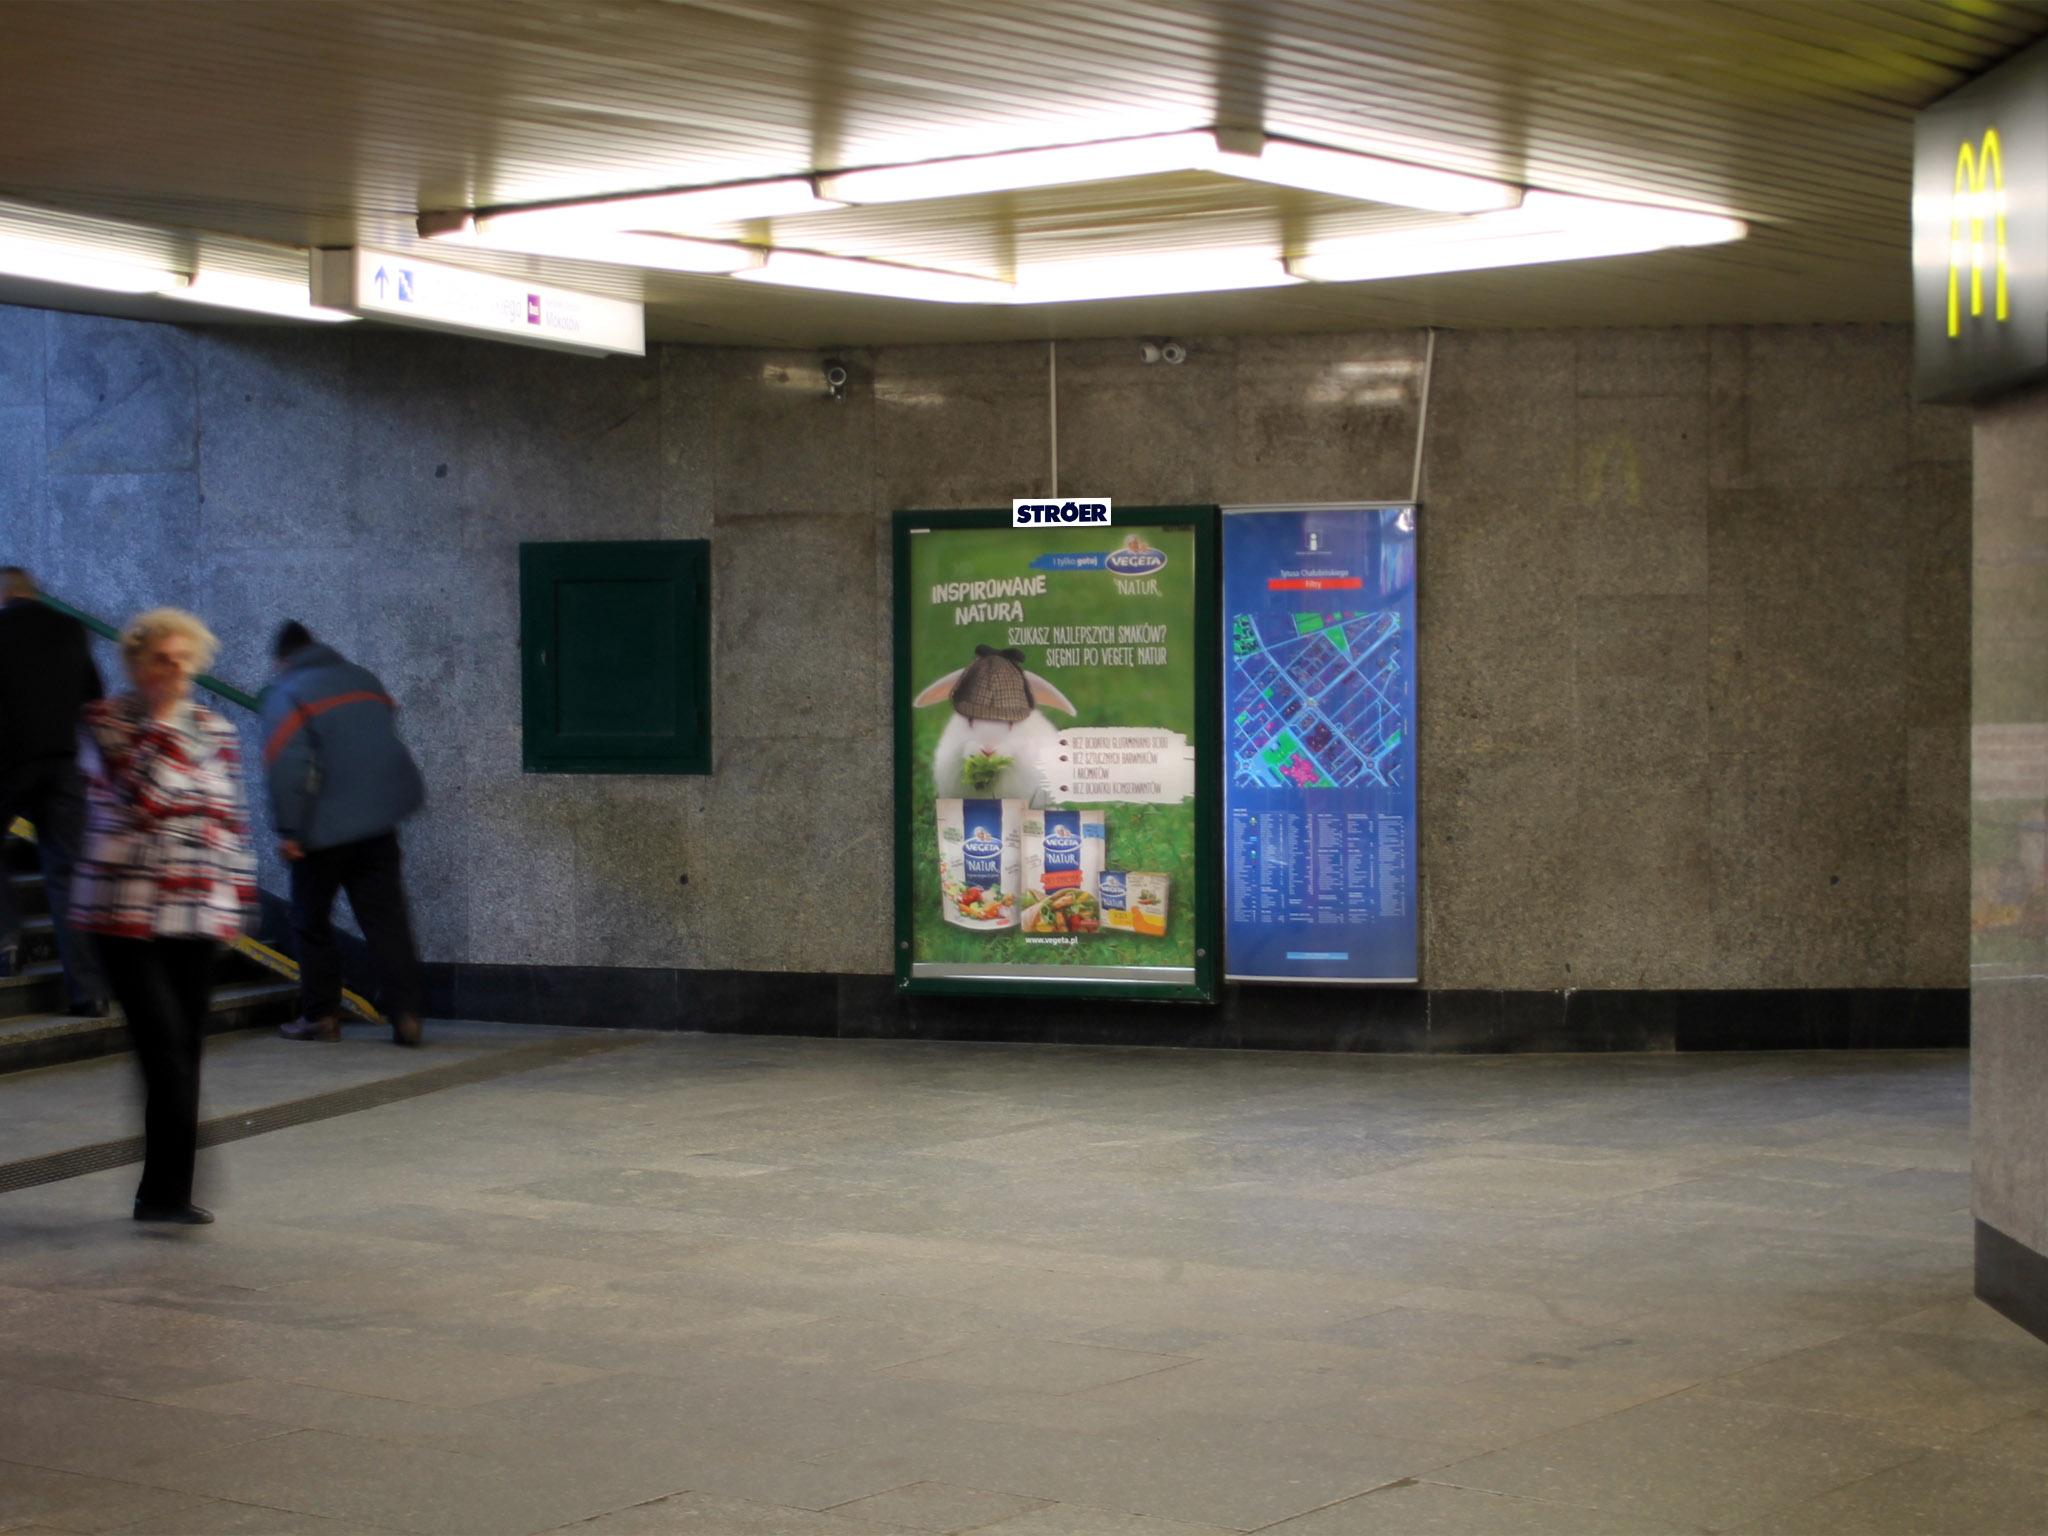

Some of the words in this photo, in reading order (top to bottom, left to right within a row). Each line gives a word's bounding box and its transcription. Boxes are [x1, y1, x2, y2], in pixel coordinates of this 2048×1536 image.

[1017, 502, 1108, 524] STRÖER
[1110, 556, 1162, 567] VEGETA
[932, 574, 1047, 604] INSPIROWANE
[1008, 626, 1050, 646] SZUKASZ
[1053, 625, 1115, 645] NAJLEPSZYCH
[1118, 622, 1167, 643] SMAKÓW?
[1083, 648, 1099, 666] PO
[1138, 648, 1168, 665] NATUR
[965, 844, 1000, 853] VEGETA
[1045, 838, 1079, 848] VEGETA
[1047, 853, 1076, 865] NATUR
[967, 860, 998, 872] NATUR
[1025, 935, 1078, 946] www.vegeta.pl
